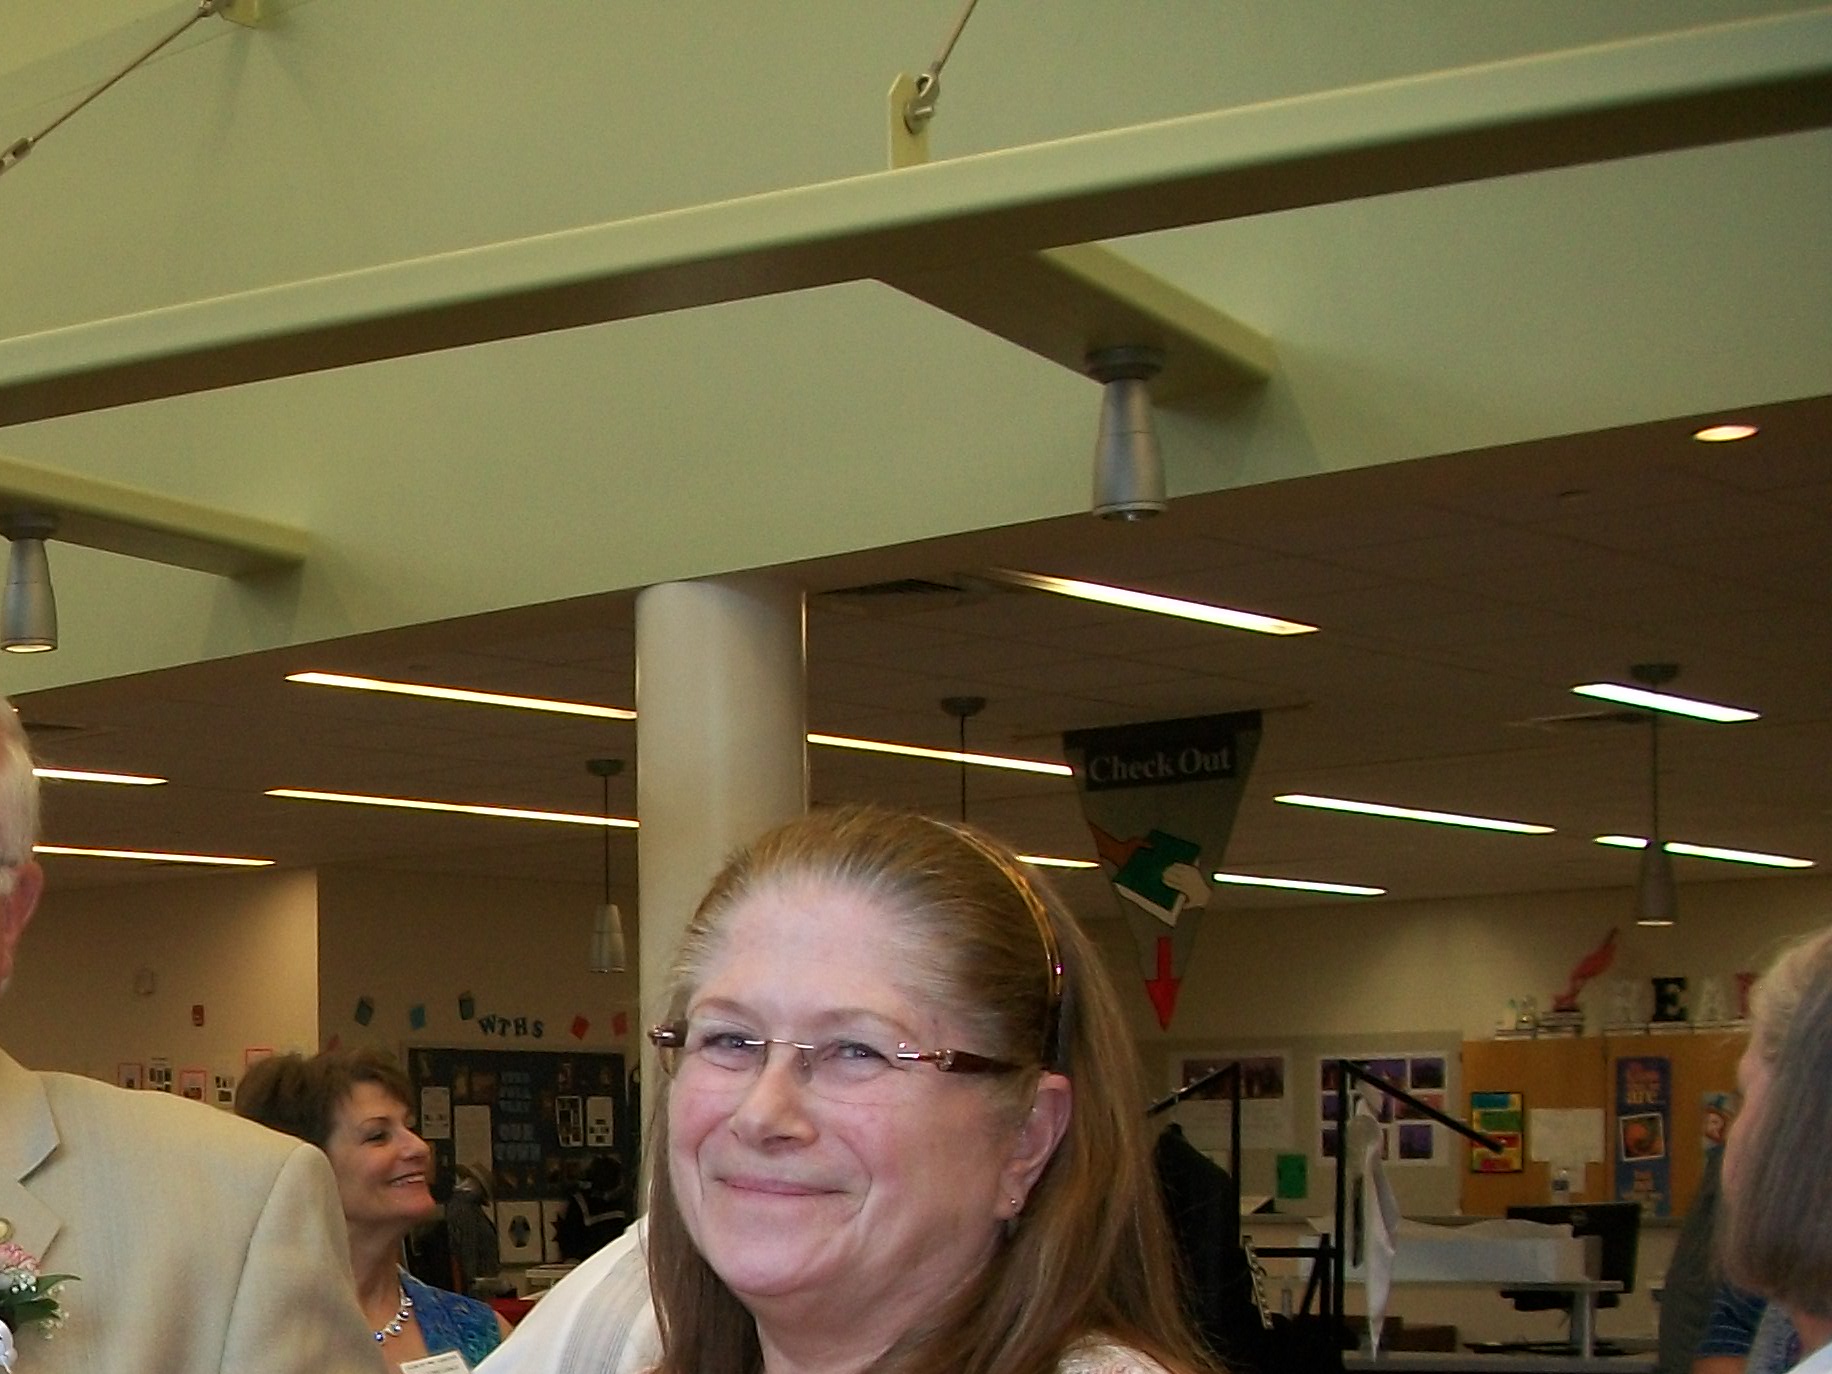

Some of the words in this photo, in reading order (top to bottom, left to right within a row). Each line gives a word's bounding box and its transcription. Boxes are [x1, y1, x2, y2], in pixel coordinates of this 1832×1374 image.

[1089, 752, 1174, 783] Check
[1180, 747, 1232, 776] Out
[478, 1014, 544, 1039] WTHS
